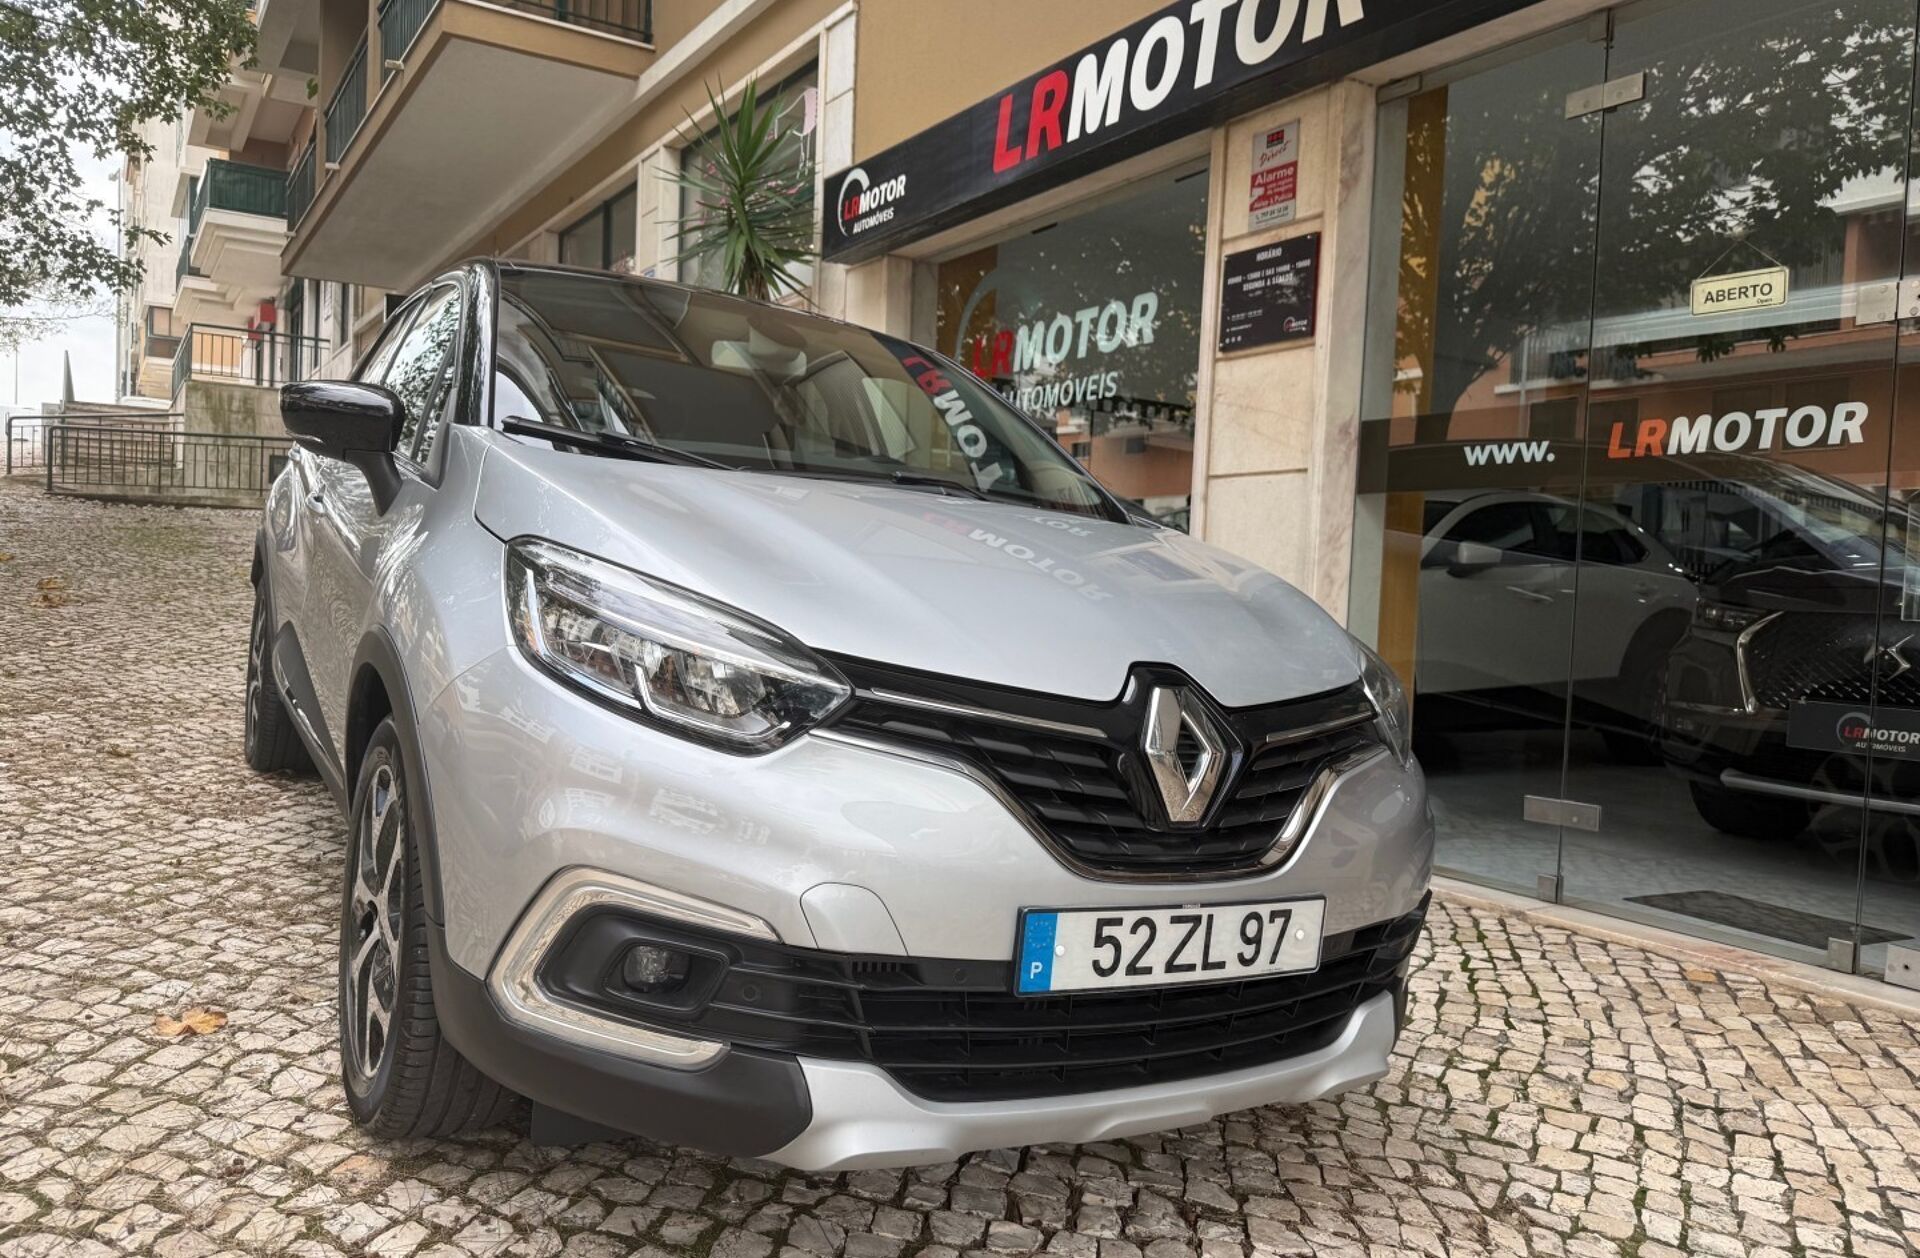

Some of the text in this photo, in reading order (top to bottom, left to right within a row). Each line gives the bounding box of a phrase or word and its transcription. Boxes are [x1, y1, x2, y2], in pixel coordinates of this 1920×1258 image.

[1254, 167, 1294, 186] Alarme
[844, 174, 906, 220] LRMOTOR
[853, 207, 894, 234] AUTOMÓVEIS
[1704, 283, 1773, 304] ABERTO
[972, 291, 1159, 378] LRMOTOR
[1463, 401, 1869, 466] www. LRMOTOR
[1030, 961, 1042, 980] P
